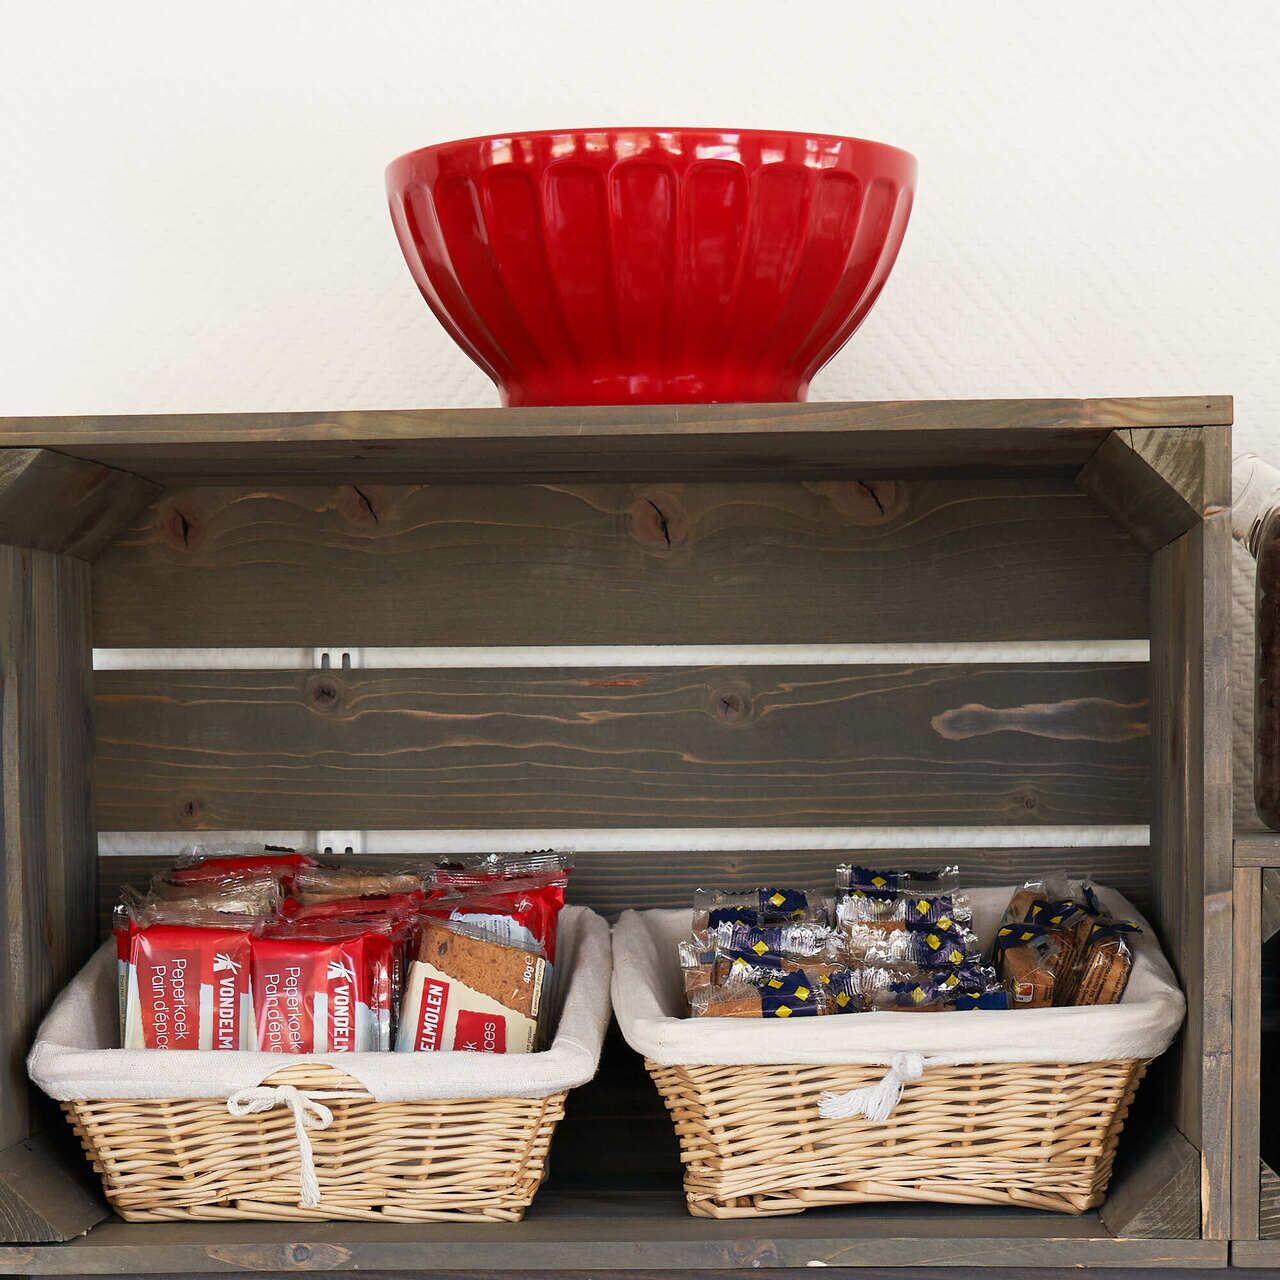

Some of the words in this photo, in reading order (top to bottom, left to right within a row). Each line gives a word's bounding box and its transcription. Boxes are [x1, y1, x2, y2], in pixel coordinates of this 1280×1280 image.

[150, 965, 166, 999] Pain
[170, 958, 190, 1041] Peperkoek
[264, 973, 280, 1007] Pain
[284, 966, 305, 1050] Peperkoek
